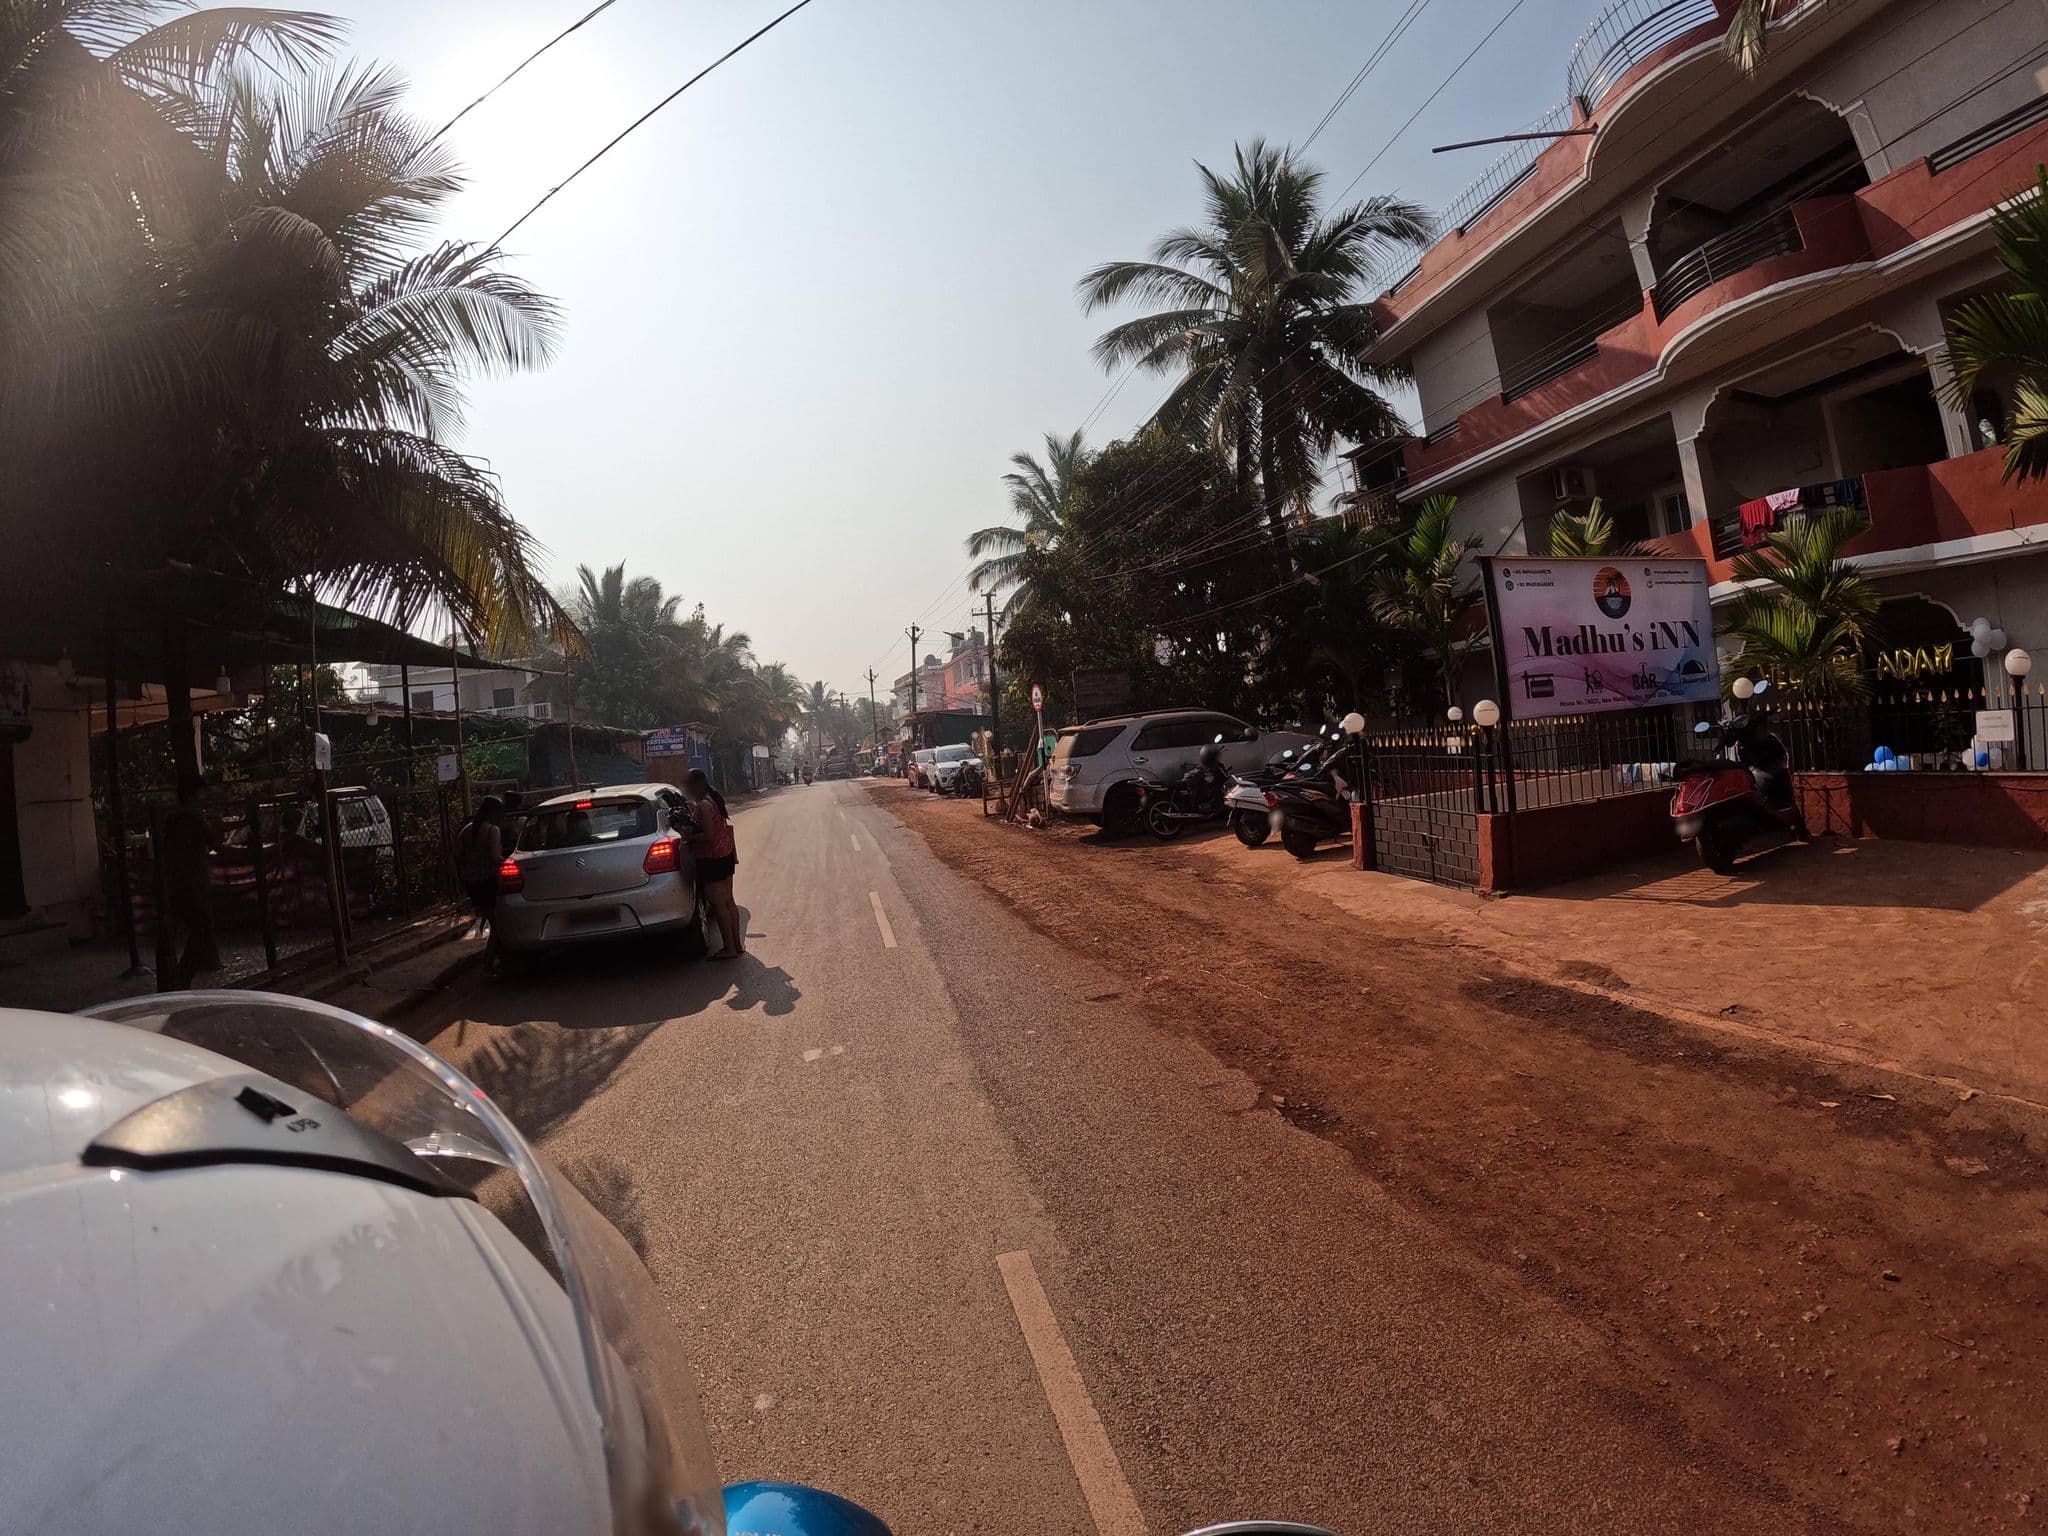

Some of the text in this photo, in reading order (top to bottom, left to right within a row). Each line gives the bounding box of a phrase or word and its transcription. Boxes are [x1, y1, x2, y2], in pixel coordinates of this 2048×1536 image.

[1521, 620, 1701, 658] Madhu's iNN
[1876, 642, 1954, 680] ADAM
[1632, 672, 1657, 690] BAR
